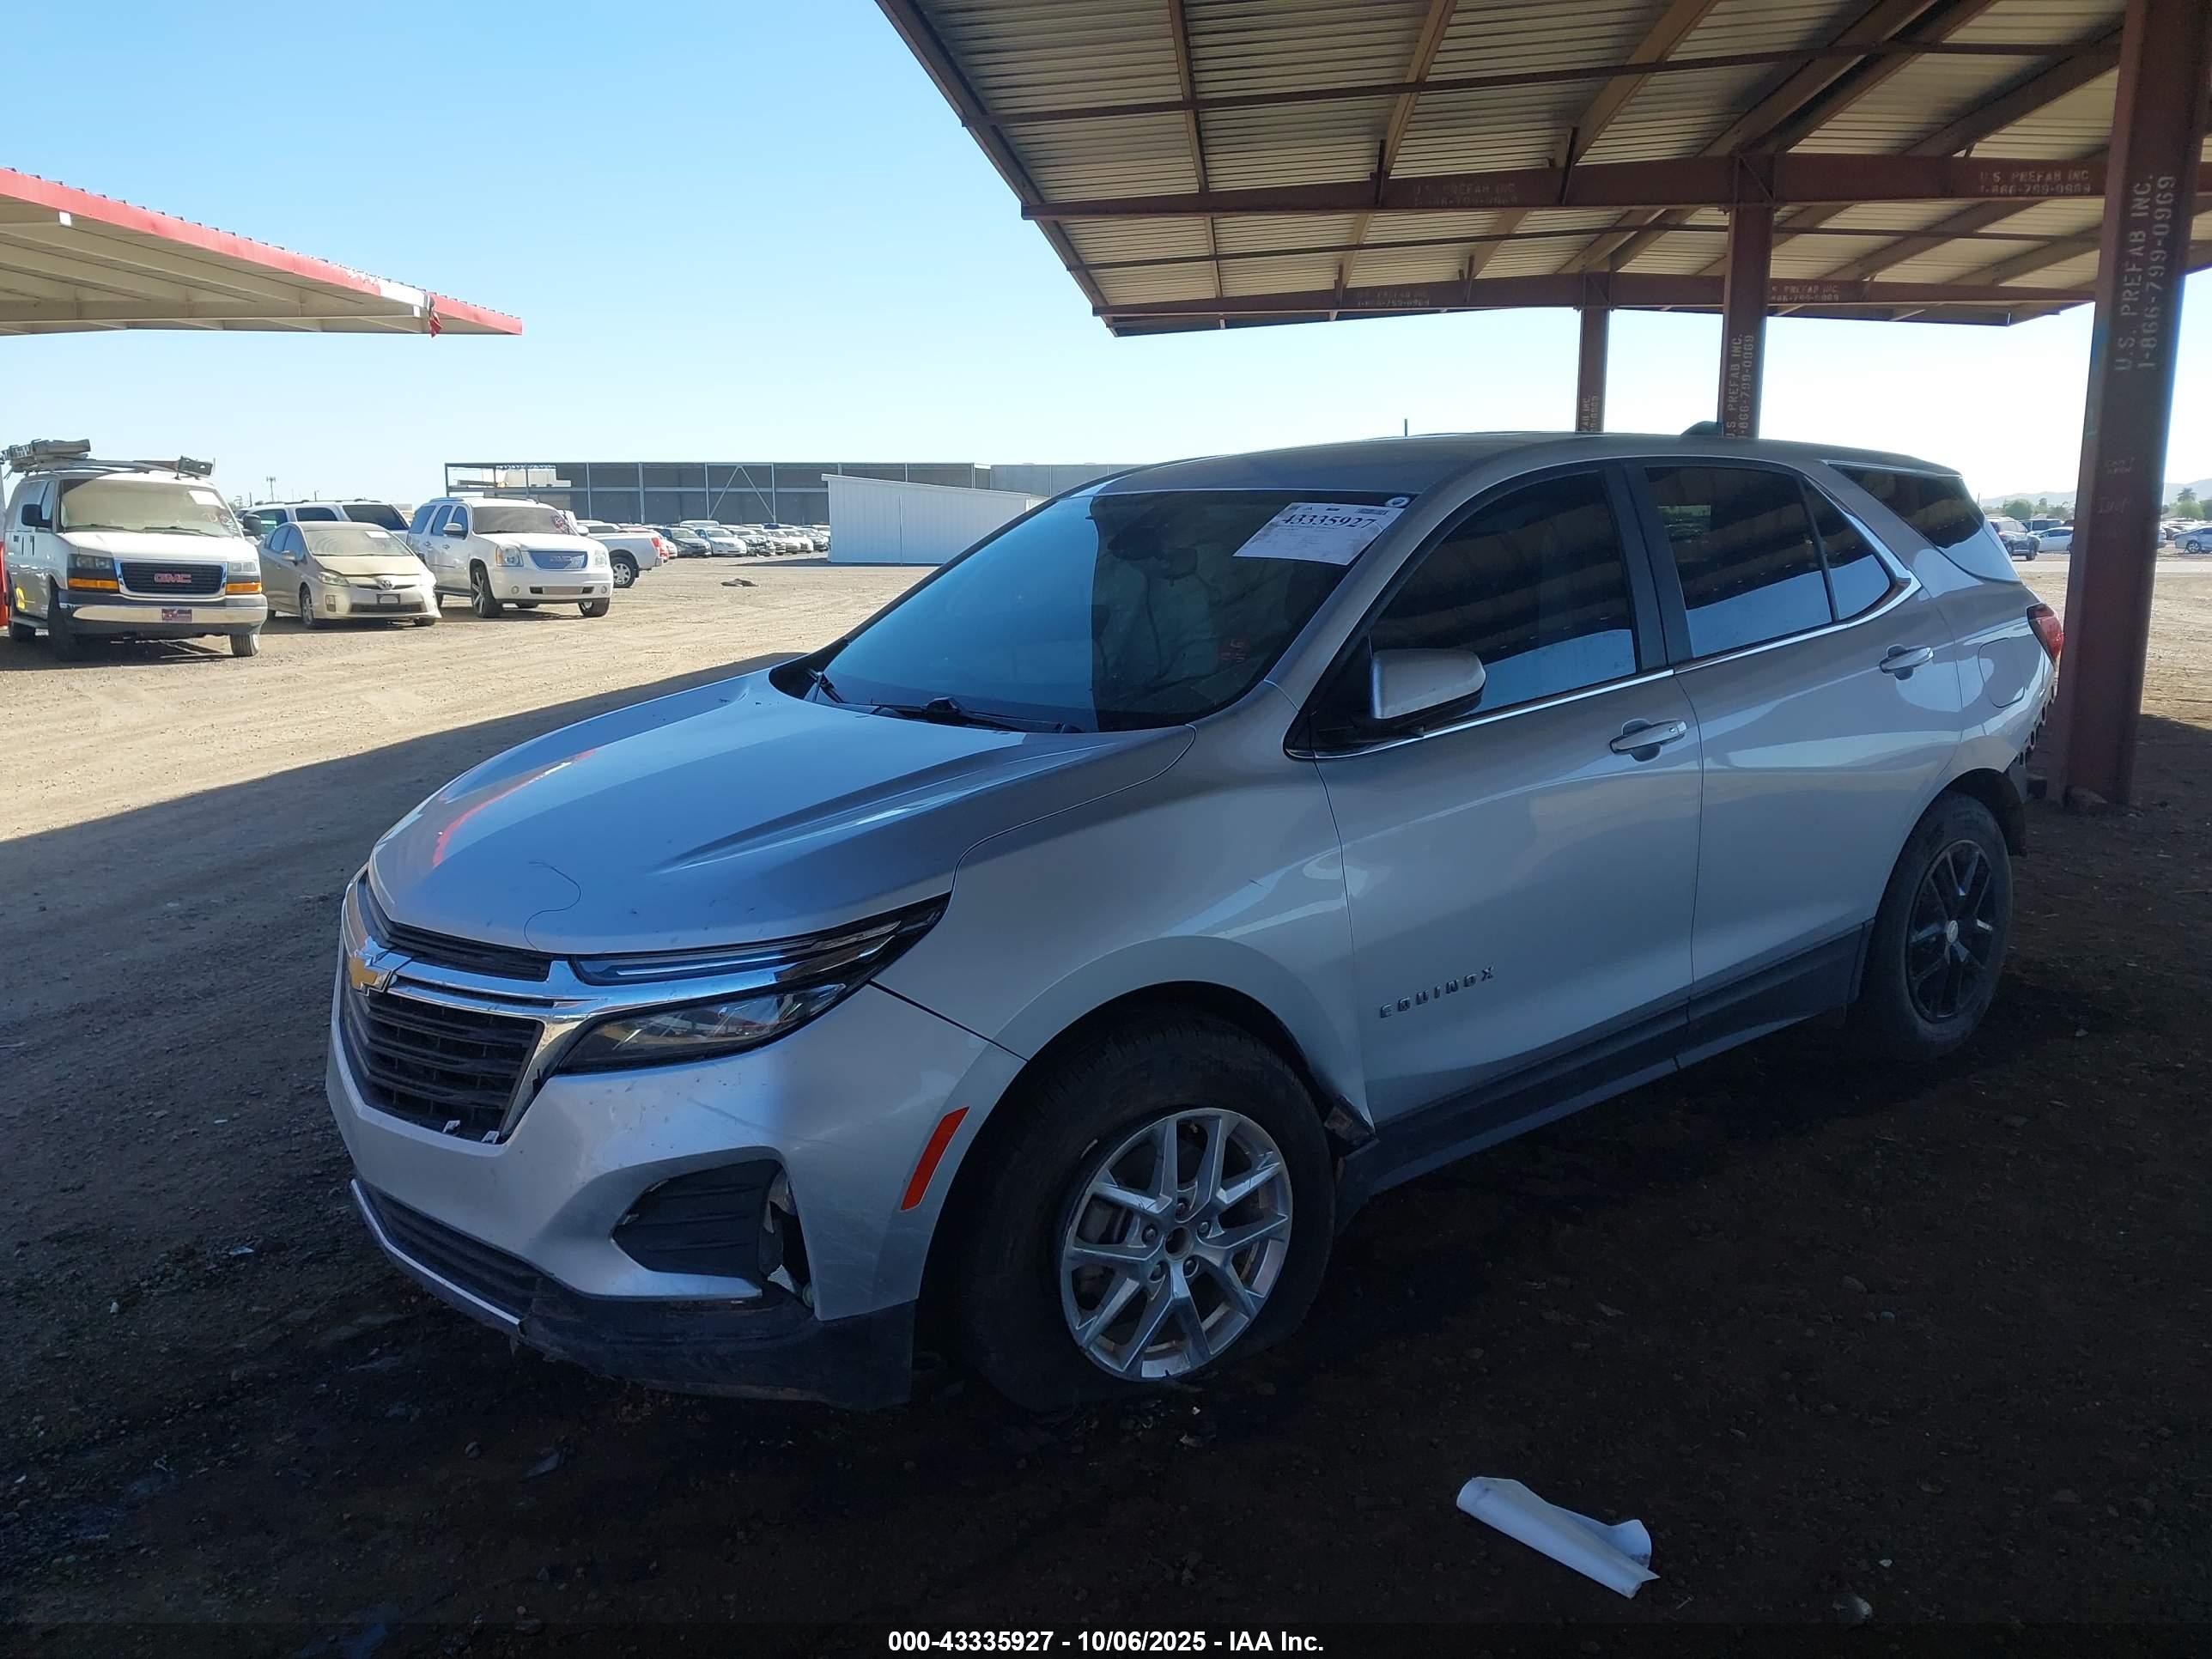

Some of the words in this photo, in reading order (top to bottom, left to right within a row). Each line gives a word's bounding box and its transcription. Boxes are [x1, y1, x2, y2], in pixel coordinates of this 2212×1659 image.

[2012, 170, 2062, 183] PREFAB
[2130, 174, 2154, 217] INC.
[2121, 230, 2146, 316] PREFAB
[2137, 175, 2176, 368] 1-866-799-0969
[1730, 332, 1743, 357] INC.
[2115, 330, 2136, 370] U.S.
[1727, 363, 1741, 411] PREFAB
[1282, 514, 1377, 529] 43335927
[154, 573, 192, 583] GMC
[1379, 963, 1495, 1018] EQUINOX
